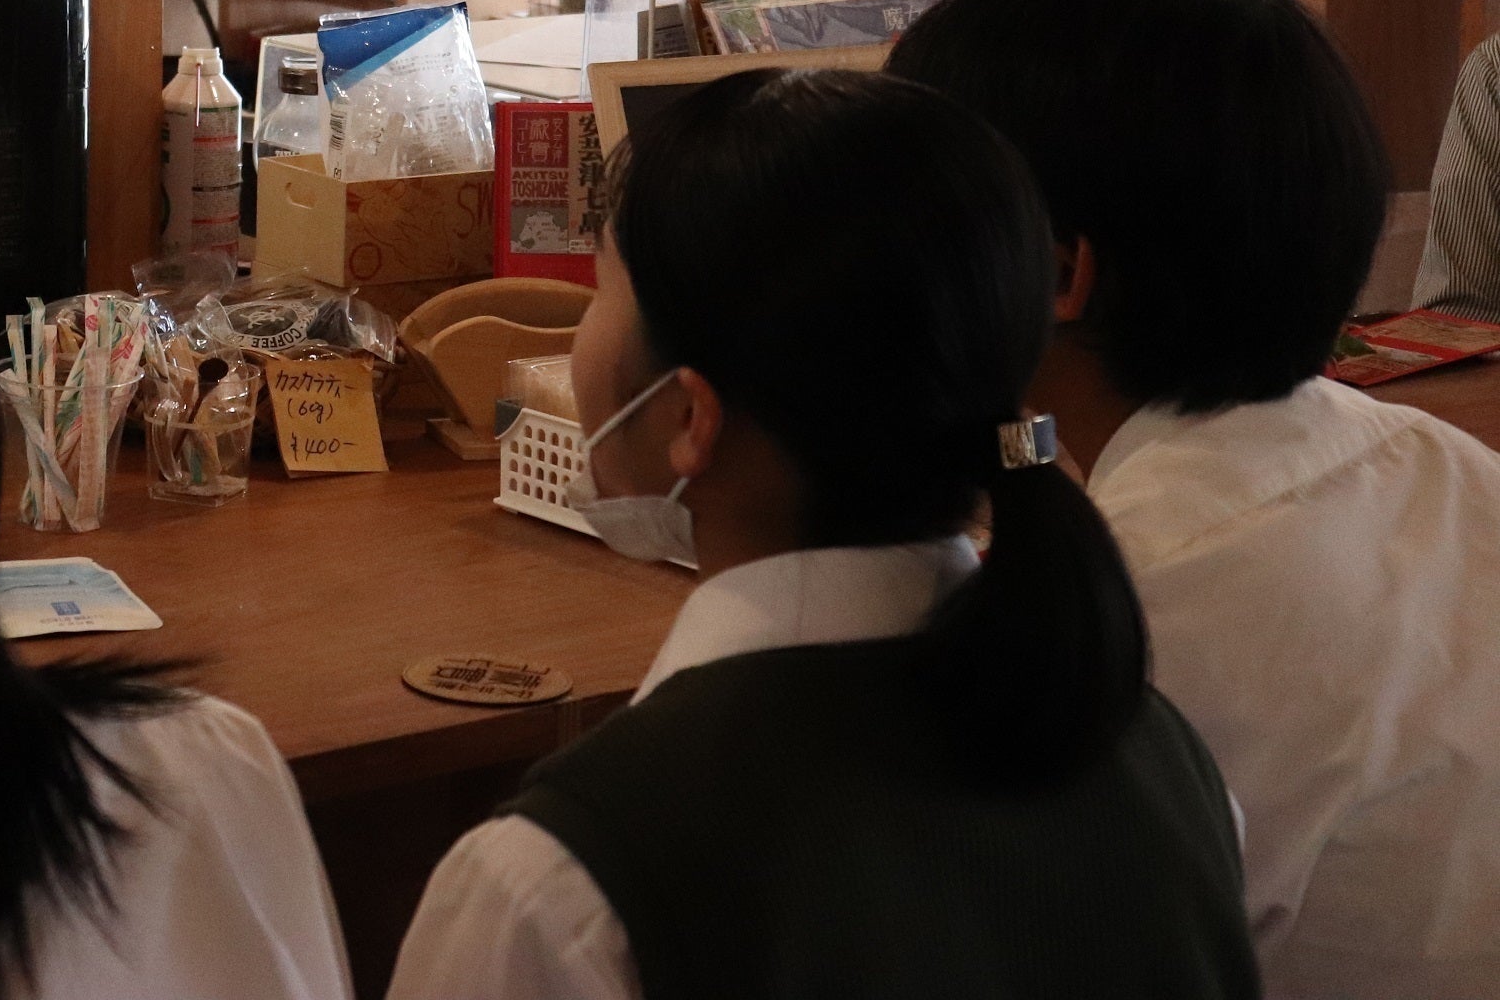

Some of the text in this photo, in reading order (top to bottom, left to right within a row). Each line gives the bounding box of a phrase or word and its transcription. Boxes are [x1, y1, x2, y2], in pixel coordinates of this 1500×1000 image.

[512, 170, 569, 180] AKITSU
[512, 181, 569, 199] TOSHIZANE
[251, 327, 302, 349] COFFEE
